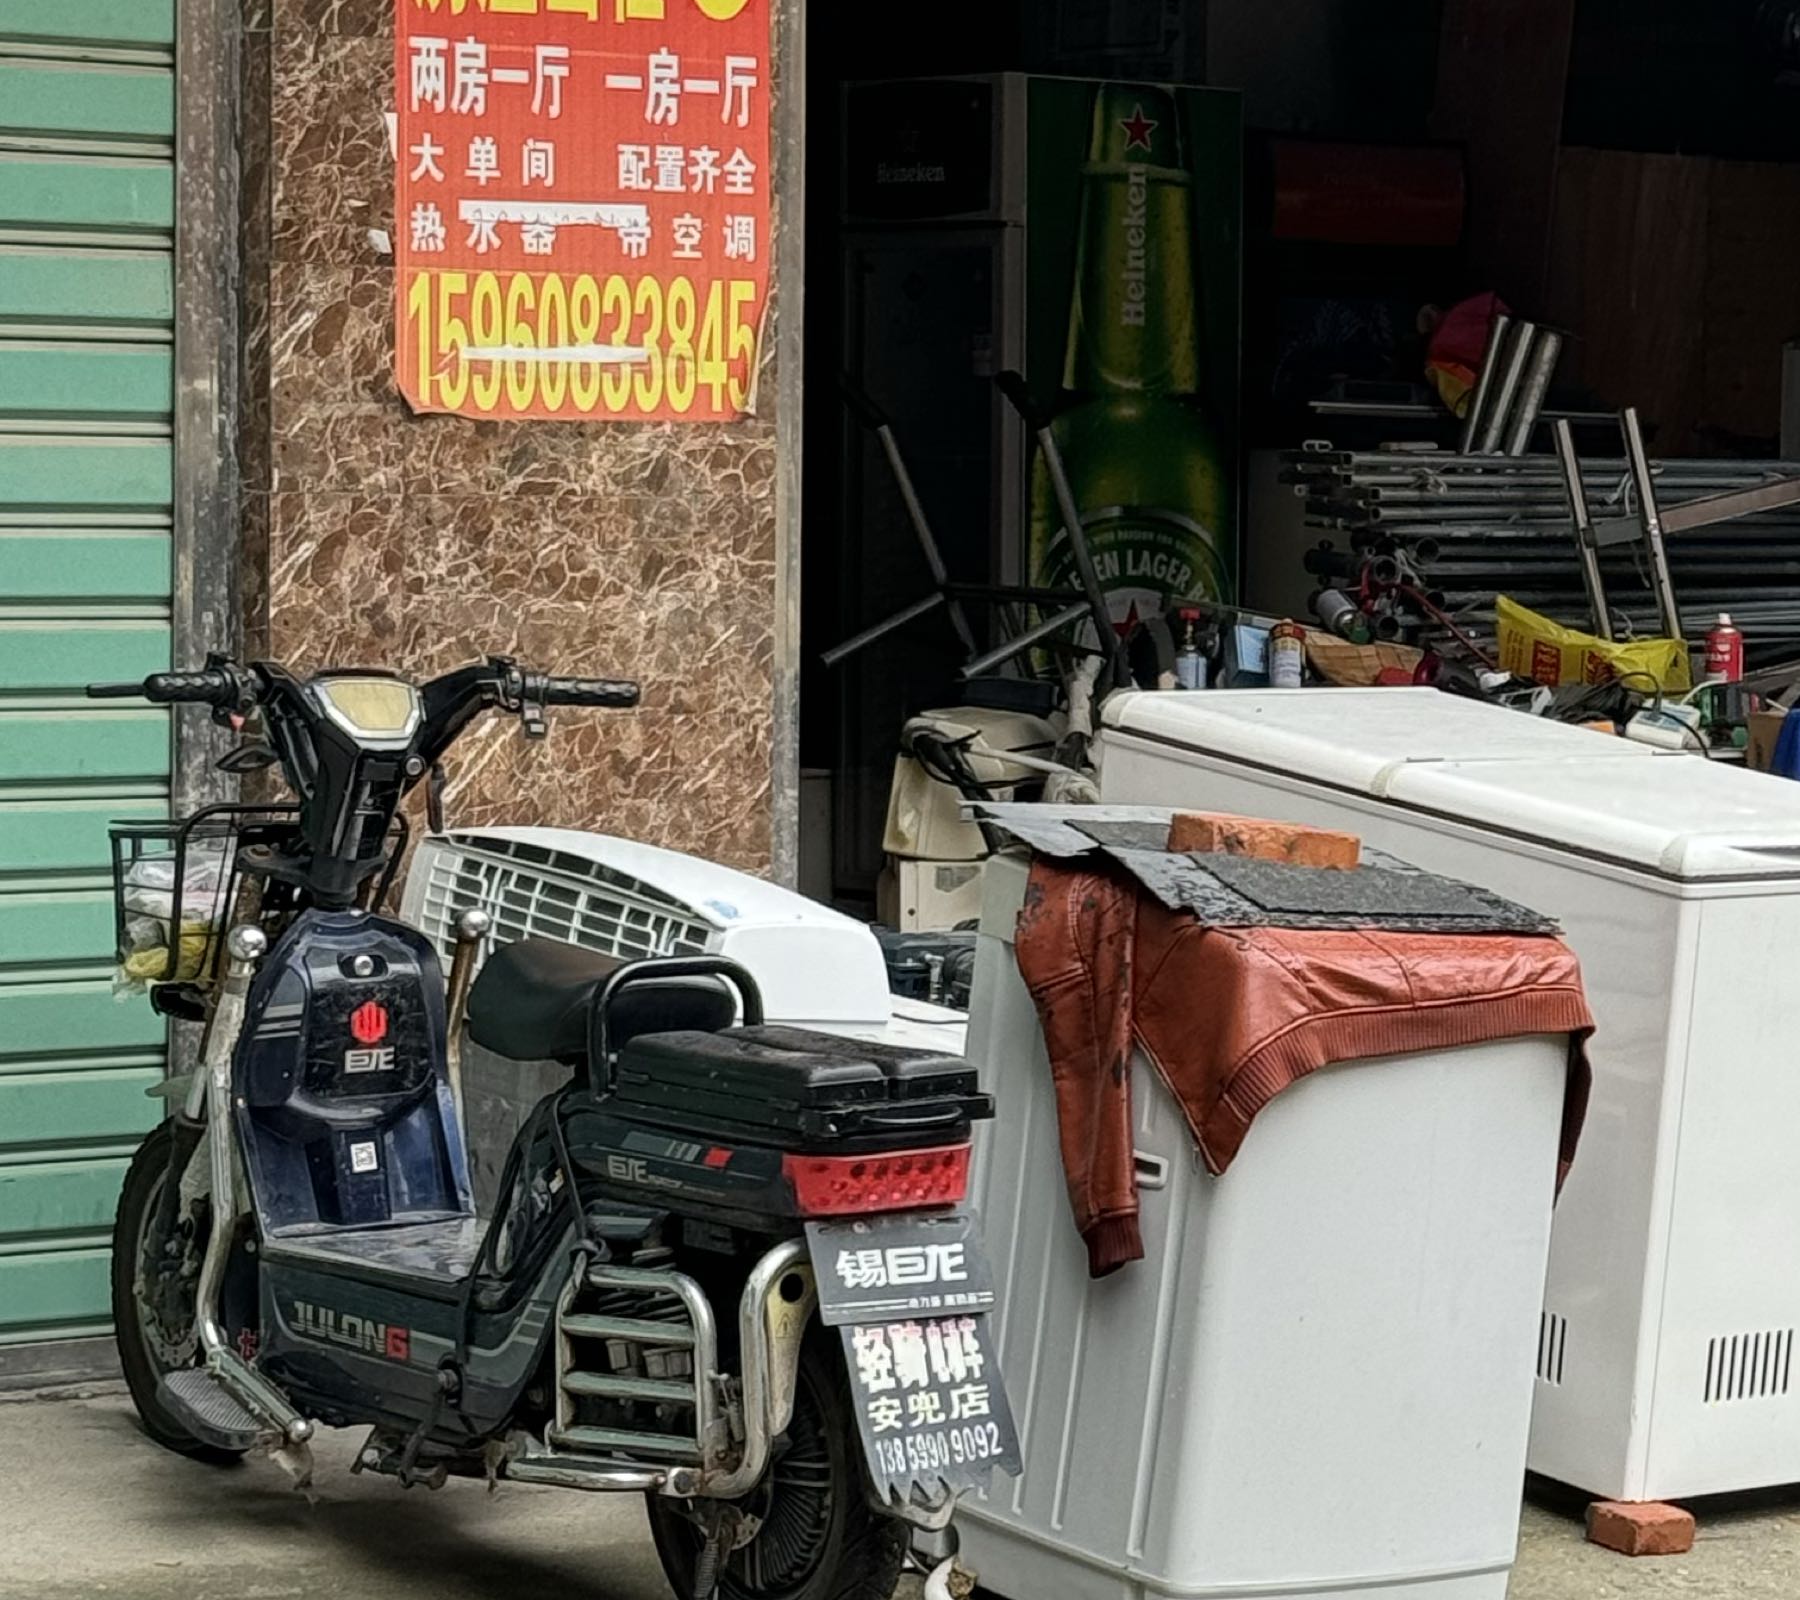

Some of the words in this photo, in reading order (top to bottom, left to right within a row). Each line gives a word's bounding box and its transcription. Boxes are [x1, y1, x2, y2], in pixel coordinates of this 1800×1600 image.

[409, 36, 571, 119] 两房一厅
[604, 46, 758, 128] 一房一厅
[410, 133, 555, 188] 大单间
[617, 144, 757, 196] 配置齐全
[1120, 164, 1147, 327] Heineken
[409, 270, 757, 416] 15960833845
[1125, 548, 1193, 592] LAGER
[867, 1383, 991, 1433] 安兜店
[950, 1421, 1004, 1464] 9092
